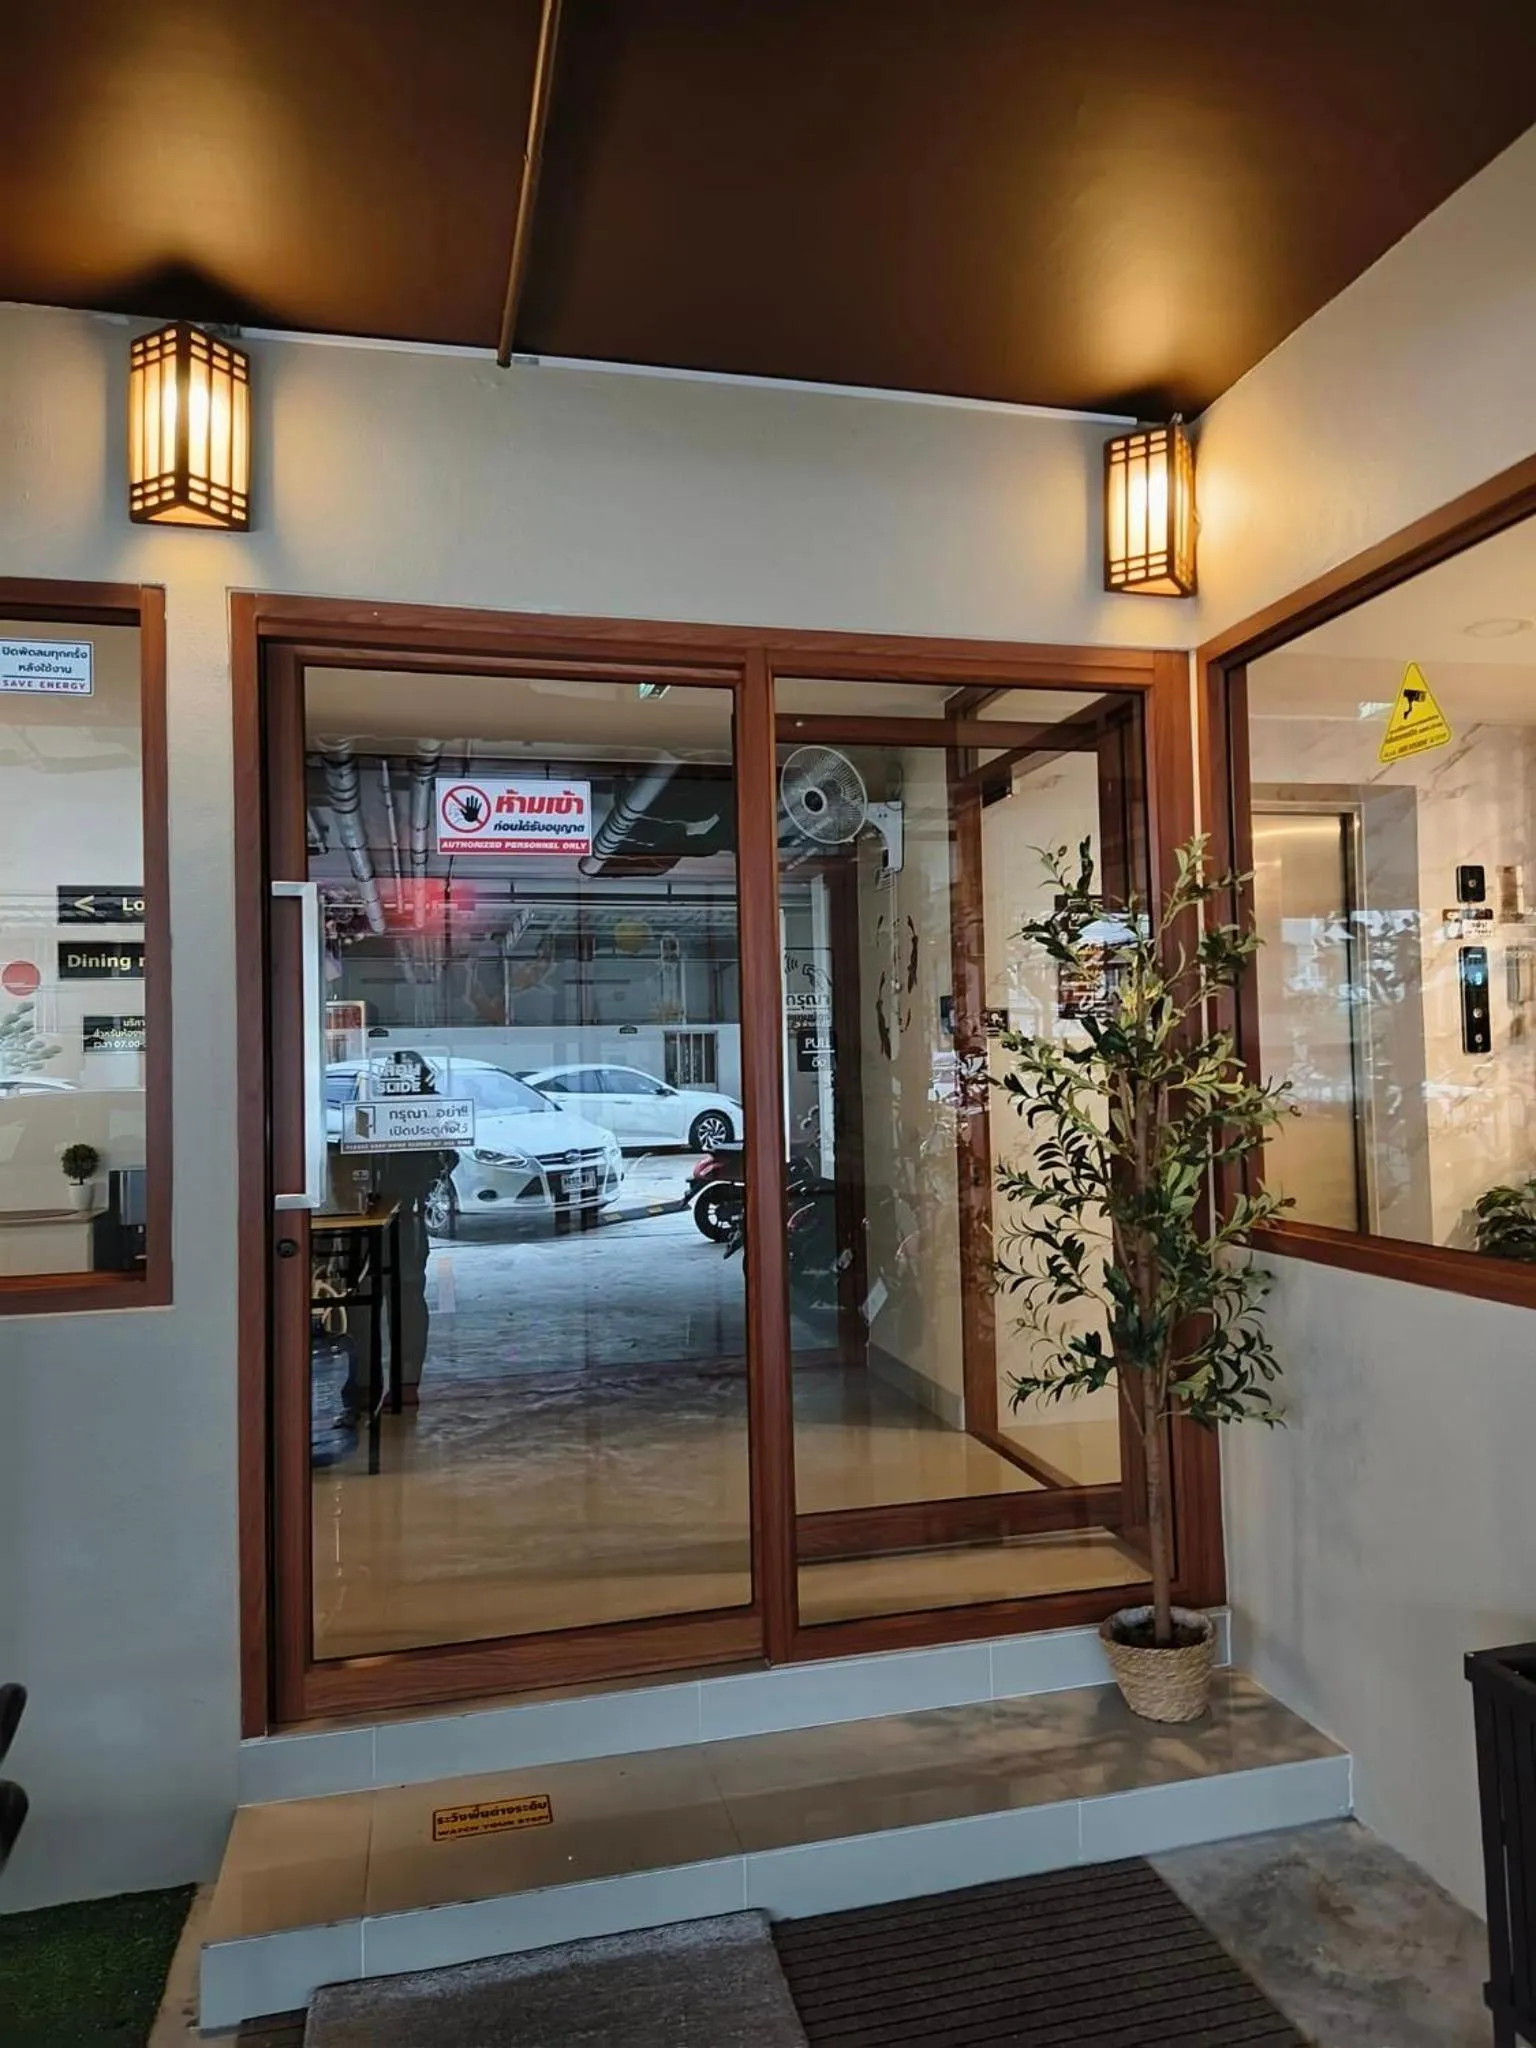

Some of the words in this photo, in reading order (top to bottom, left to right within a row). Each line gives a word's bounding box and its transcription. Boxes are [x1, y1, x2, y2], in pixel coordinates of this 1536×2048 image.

[2, 646, 88, 661] ปิดพัดลมทุกครั้ง
[18, 662, 72, 674] หลังใช้งาน
[2, 679, 33, 688] SAVE
[39, 680, 86, 690] ENERGY
[495, 788, 584, 815] ห้ามเข้า
[493, 820, 585, 835] ก่อนได้รับอนุญาต
[441, 841, 503, 850] AUTHORIZED
[504, 841, 560, 850] PERSONNEL
[562, 842, 588, 850] ONLY
[122, 897, 146, 912] Lo
[67, 953, 131, 971] Dining
[804, 1038, 831, 1049] PULL
[376, 1081, 421, 1093] SLIDE
[437, 1801, 547, 1825] ระวังพื้นต่างระดับ
[438, 1826, 479, 1836] WATCH
[482, 1820, 515, 1830] YOUR
